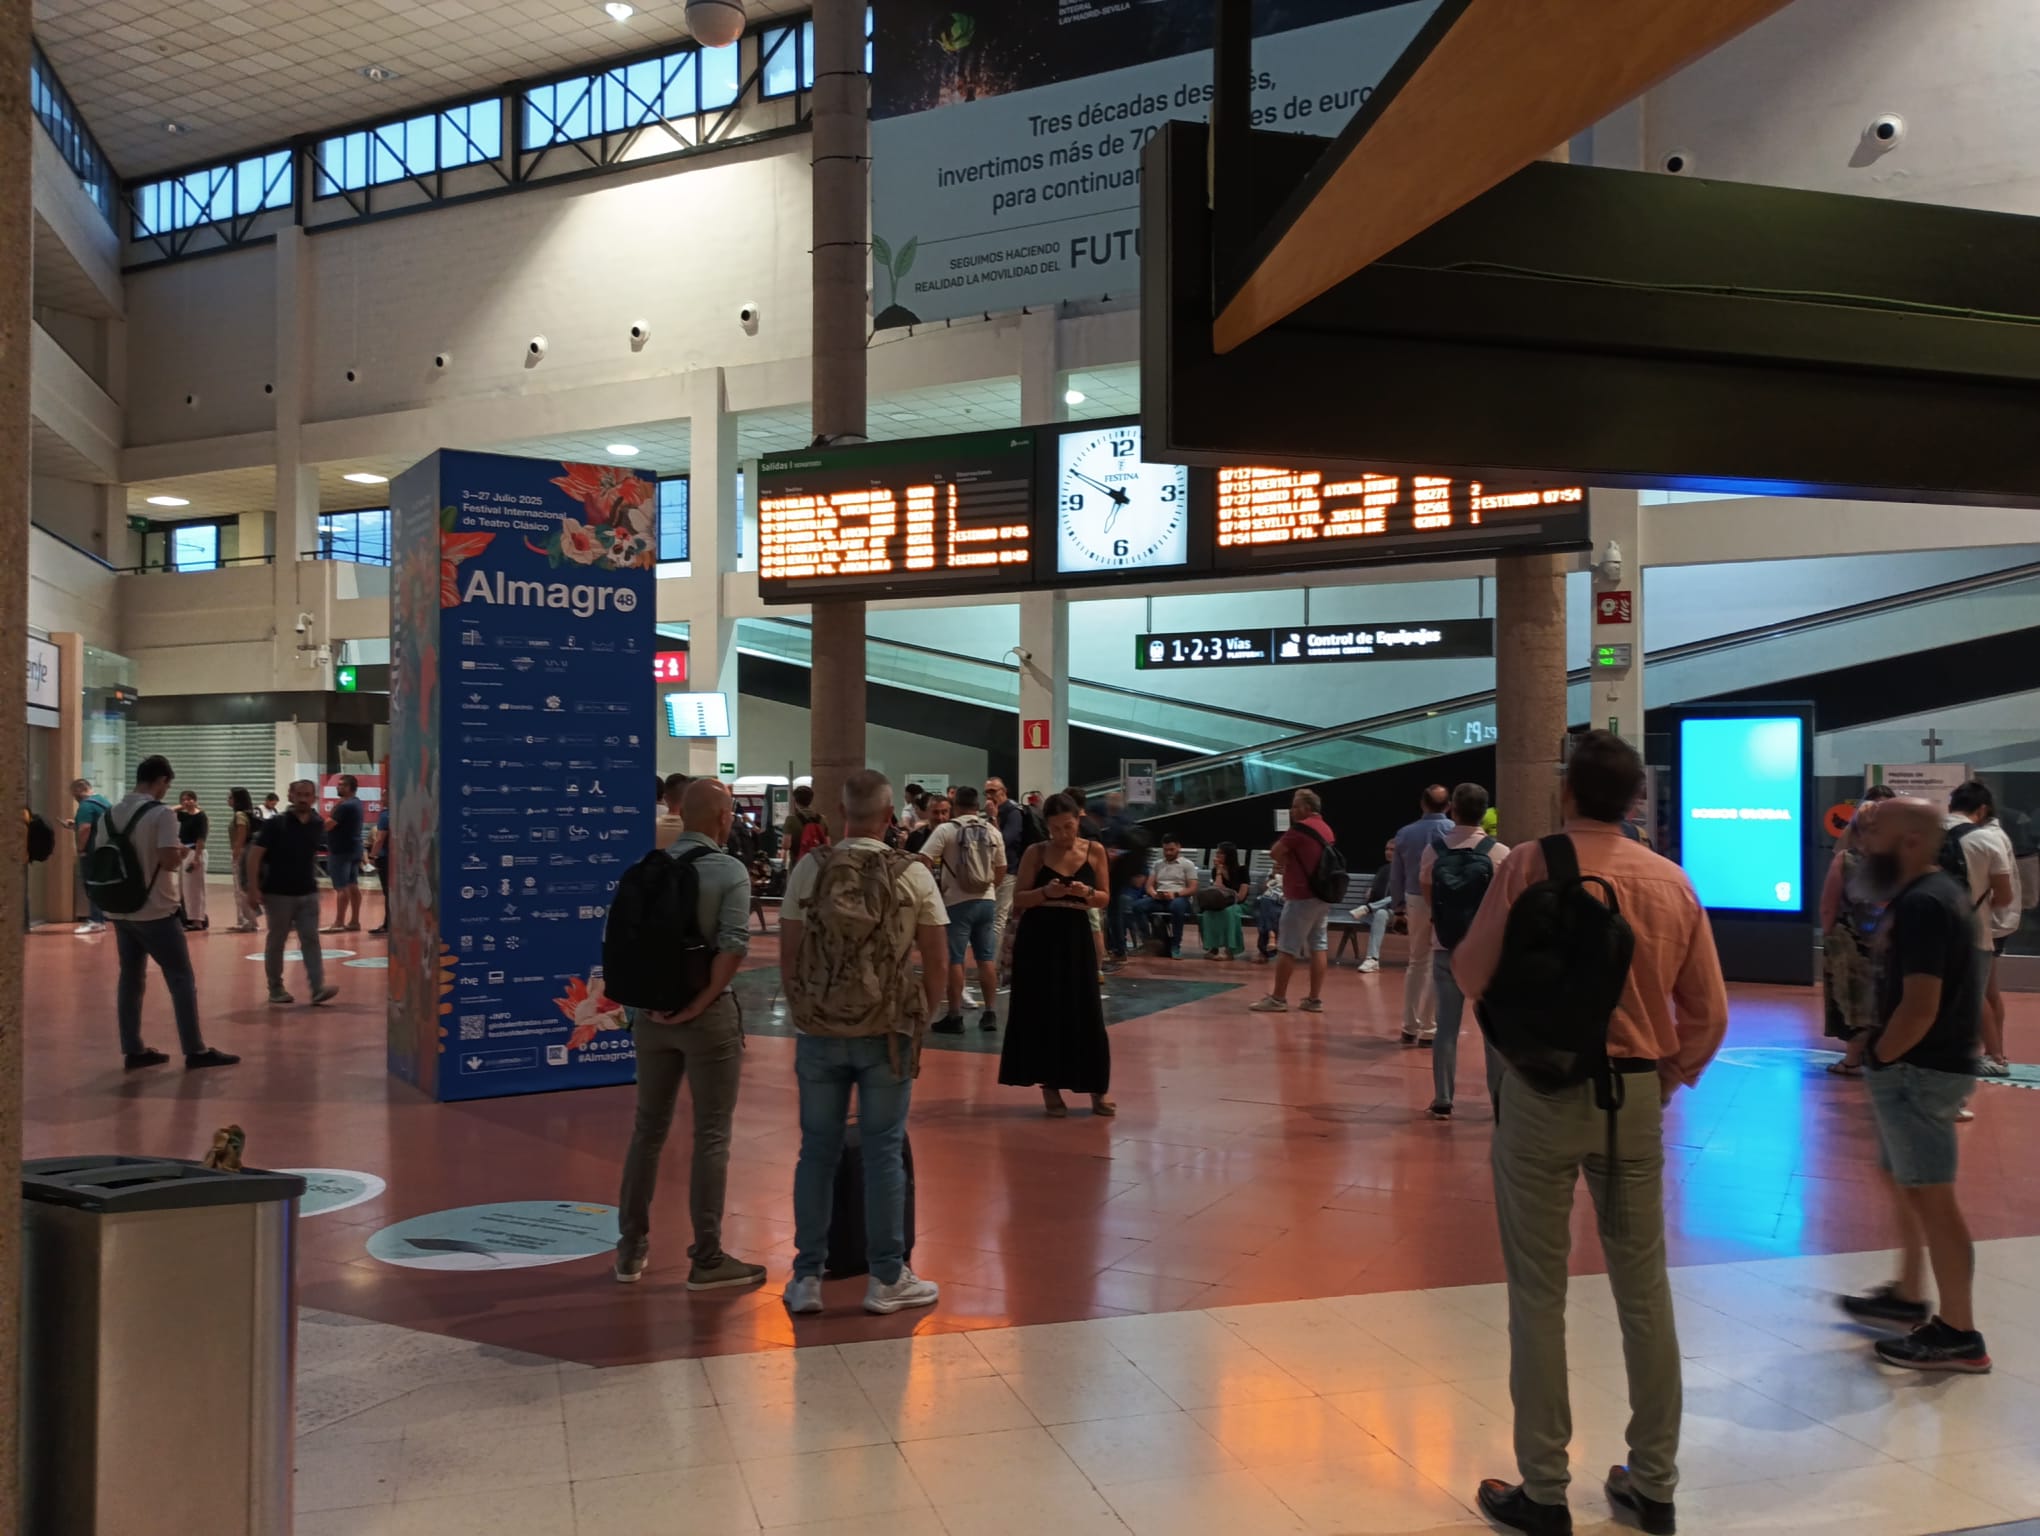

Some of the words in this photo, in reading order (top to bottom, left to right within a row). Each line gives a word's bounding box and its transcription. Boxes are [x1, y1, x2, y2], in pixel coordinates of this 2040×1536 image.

[1028, 113, 1072, 136] Tres
[1078, 93, 1168, 127] décadas
[1284, 95, 1312, 119] de
[938, 153, 1044, 187] invertimos
[1049, 141, 1093, 166] más
[1099, 134, 1124, 156] de
[993, 188, 1036, 215] para
[1042, 167, 1142, 201] continuar
[950, 251, 1004, 270] SEGUIMOS
[1006, 241, 1061, 261] HACIENDO
[915, 275, 965, 293] REALIDAD
[966, 271, 979, 286] LA
[981, 263, 1039, 283] MOVILIDAD
[1040, 260, 1061, 274] DEL
[1110, 439, 1135, 457] 12
[761, 462, 788, 472] Salidas
[1104, 473, 1139, 482] FESTINA
[493, 494, 517, 504] Julio
[518, 495, 544, 506] 2025
[1160, 485, 1176, 502] 3
[1069, 494, 1084, 511] 9
[463, 504, 501, 515] Festival
[503, 506, 567, 520] Internacional
[463, 516, 476, 526] de
[478, 517, 510, 528] Teatro
[512, 520, 549, 532] Clásico
[1113, 539, 1129, 556] 6
[617, 595, 634, 606] 48
[1226, 637, 1251, 649] Vías
[1307, 632, 1353, 646] Control
[1356, 632, 1373, 644] de
